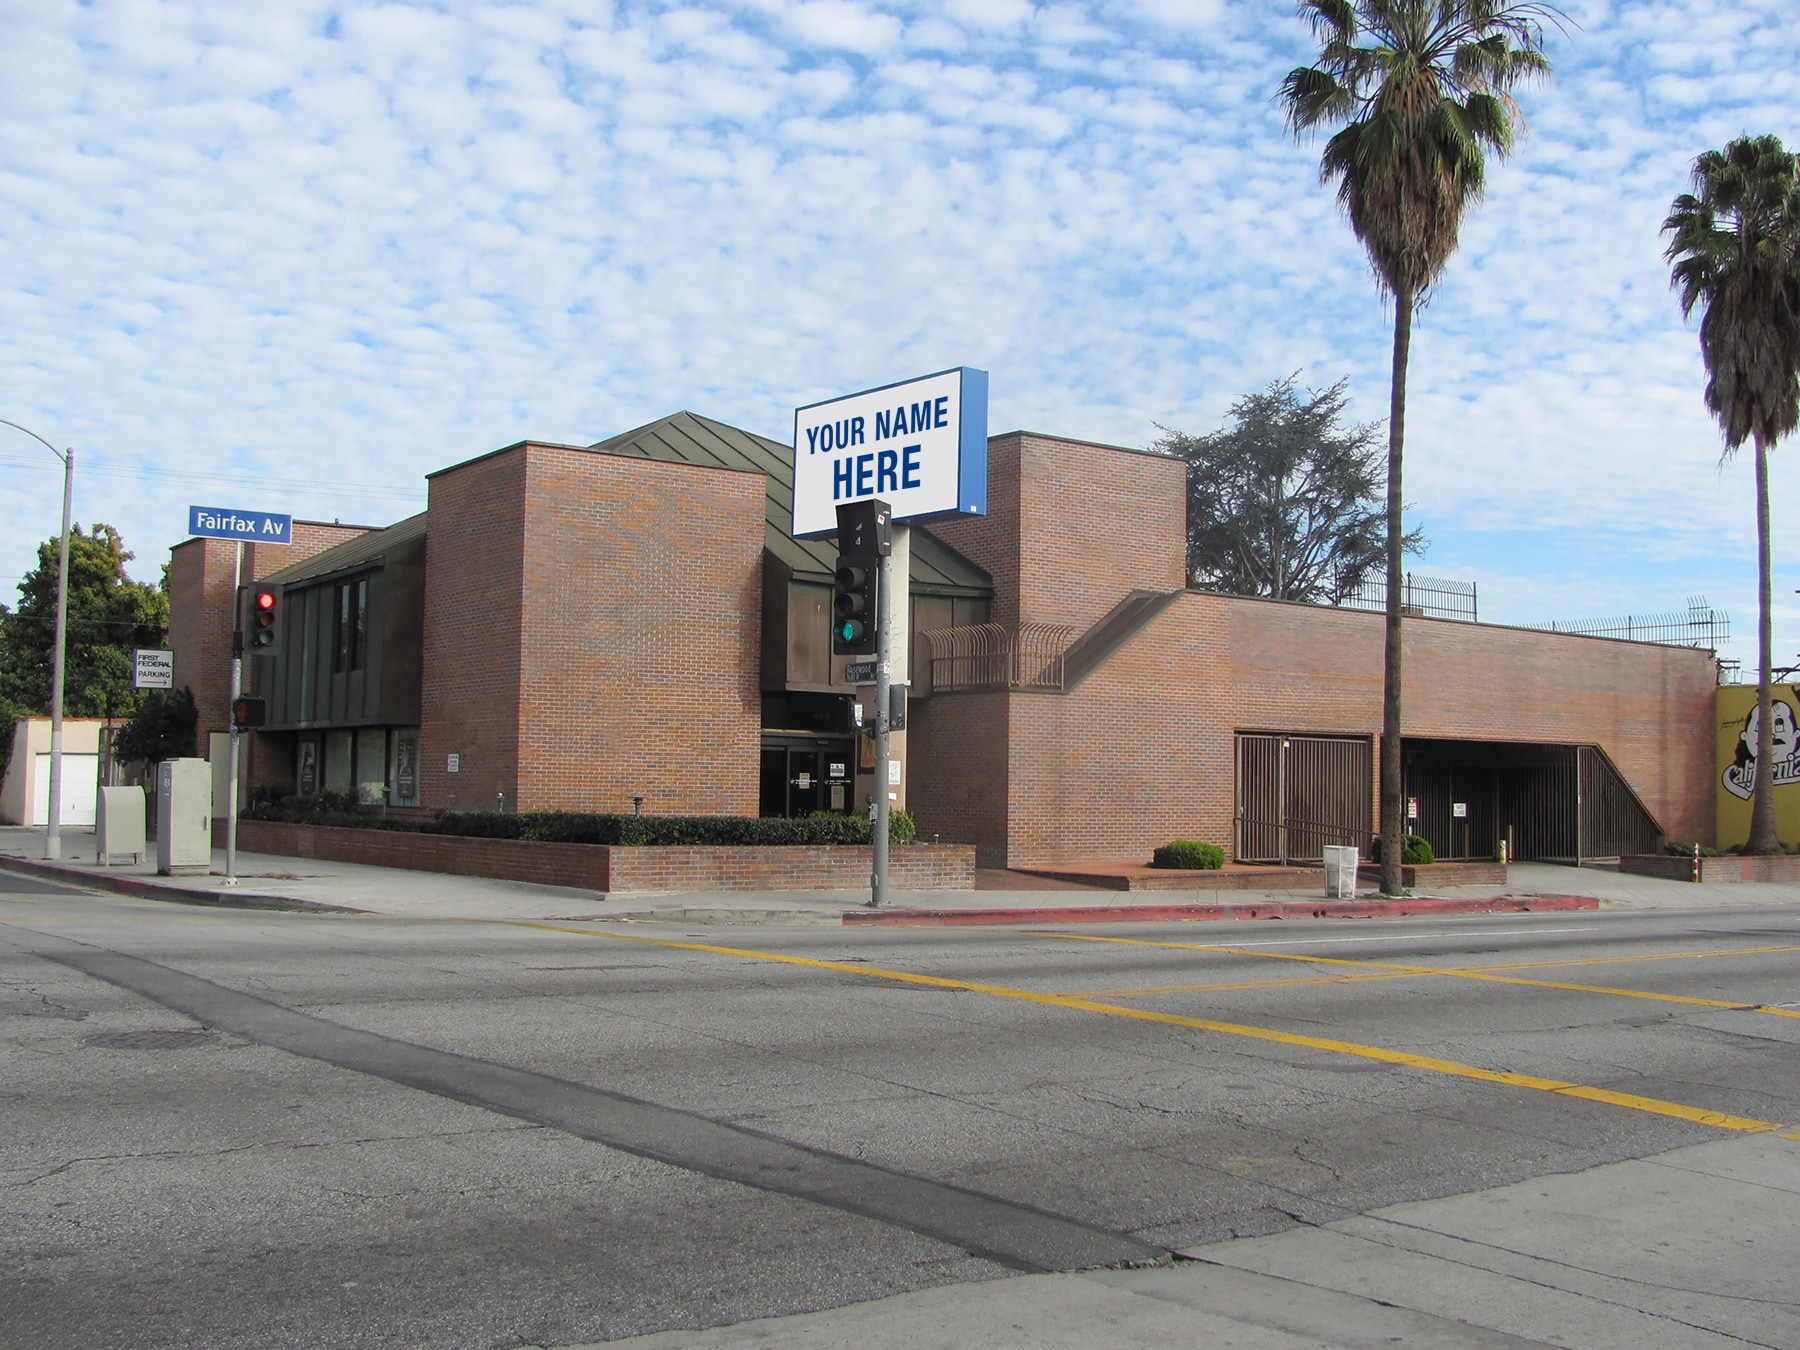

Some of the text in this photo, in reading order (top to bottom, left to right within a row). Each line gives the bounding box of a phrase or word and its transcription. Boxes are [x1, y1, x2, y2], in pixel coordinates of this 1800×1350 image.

[806, 395, 949, 455] YOUR NAME
[833, 444, 921, 501] HERE
[197, 512, 284, 535] Fairfax Av
[138, 670, 171, 679] PARKING
